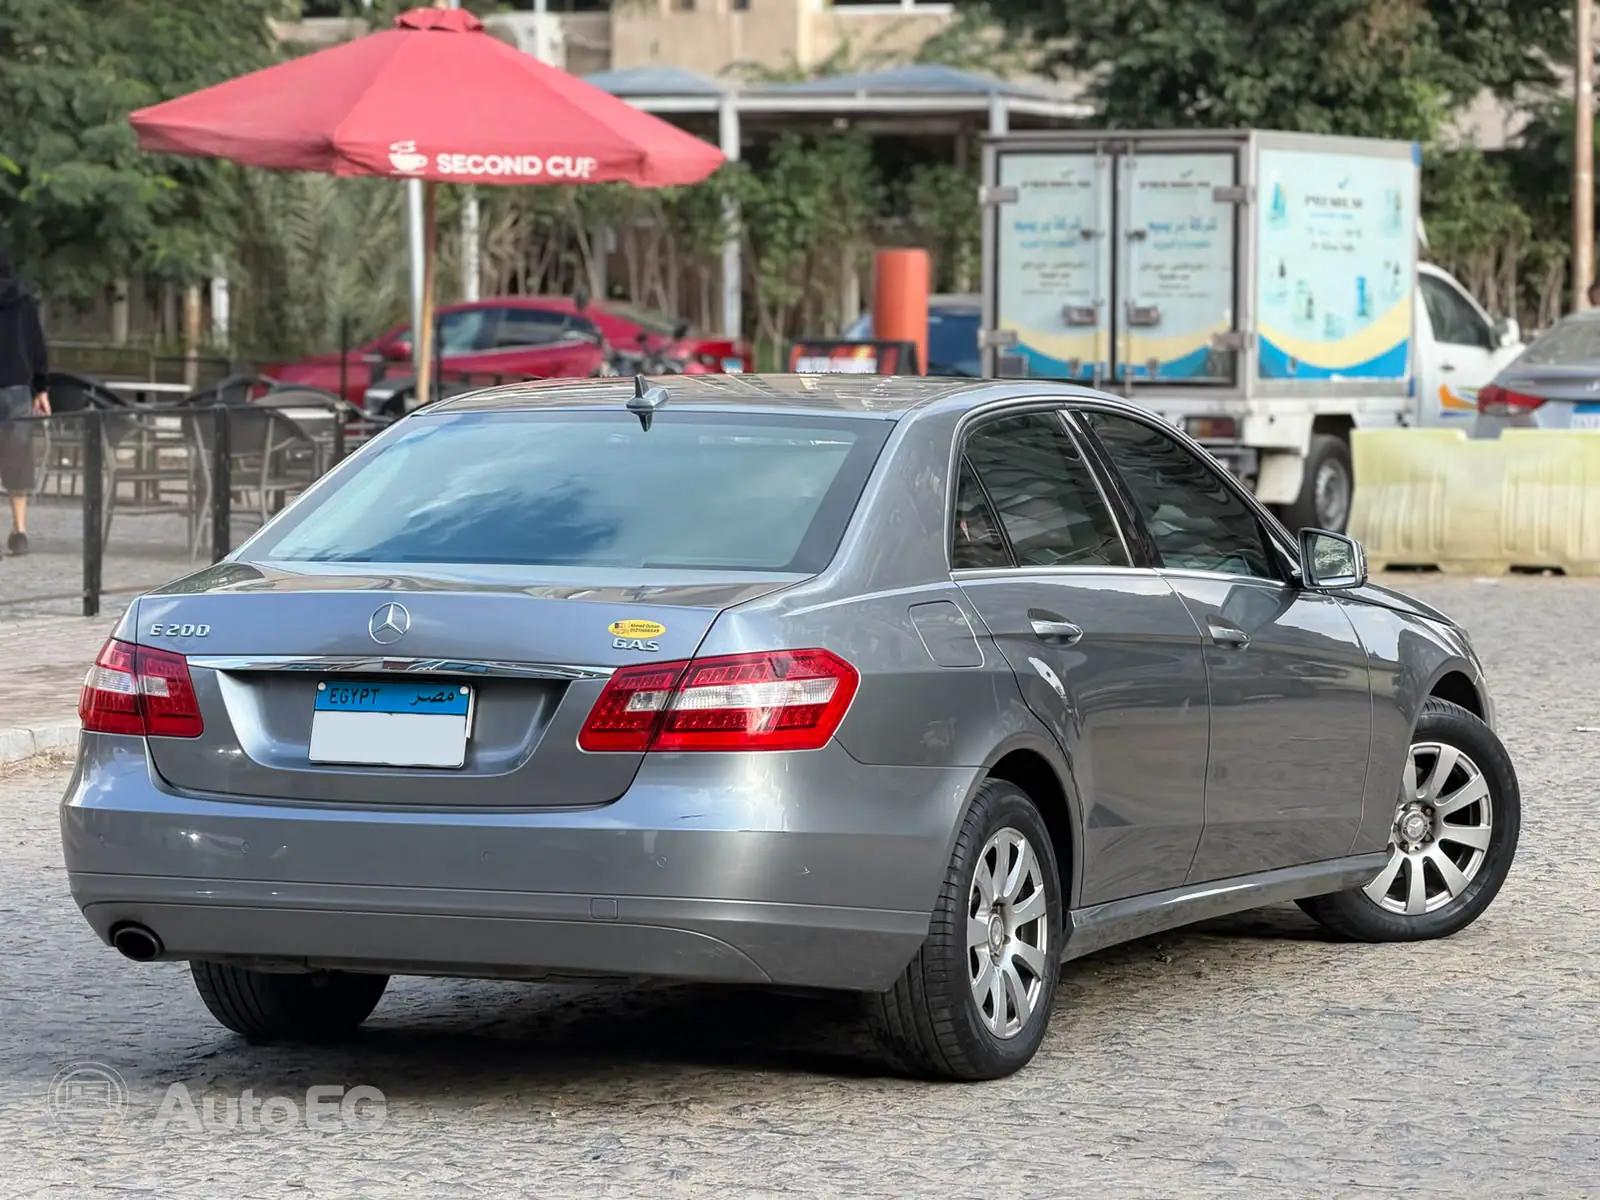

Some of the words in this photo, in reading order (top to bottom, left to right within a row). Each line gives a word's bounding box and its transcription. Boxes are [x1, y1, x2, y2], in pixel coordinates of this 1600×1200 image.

[436, 153, 543, 175] SECOND
[545, 156, 598, 179] CUP
[612, 637, 660, 652] GAS
[329, 687, 381, 705] EGYPT
[408, 690, 456, 707] مصر
